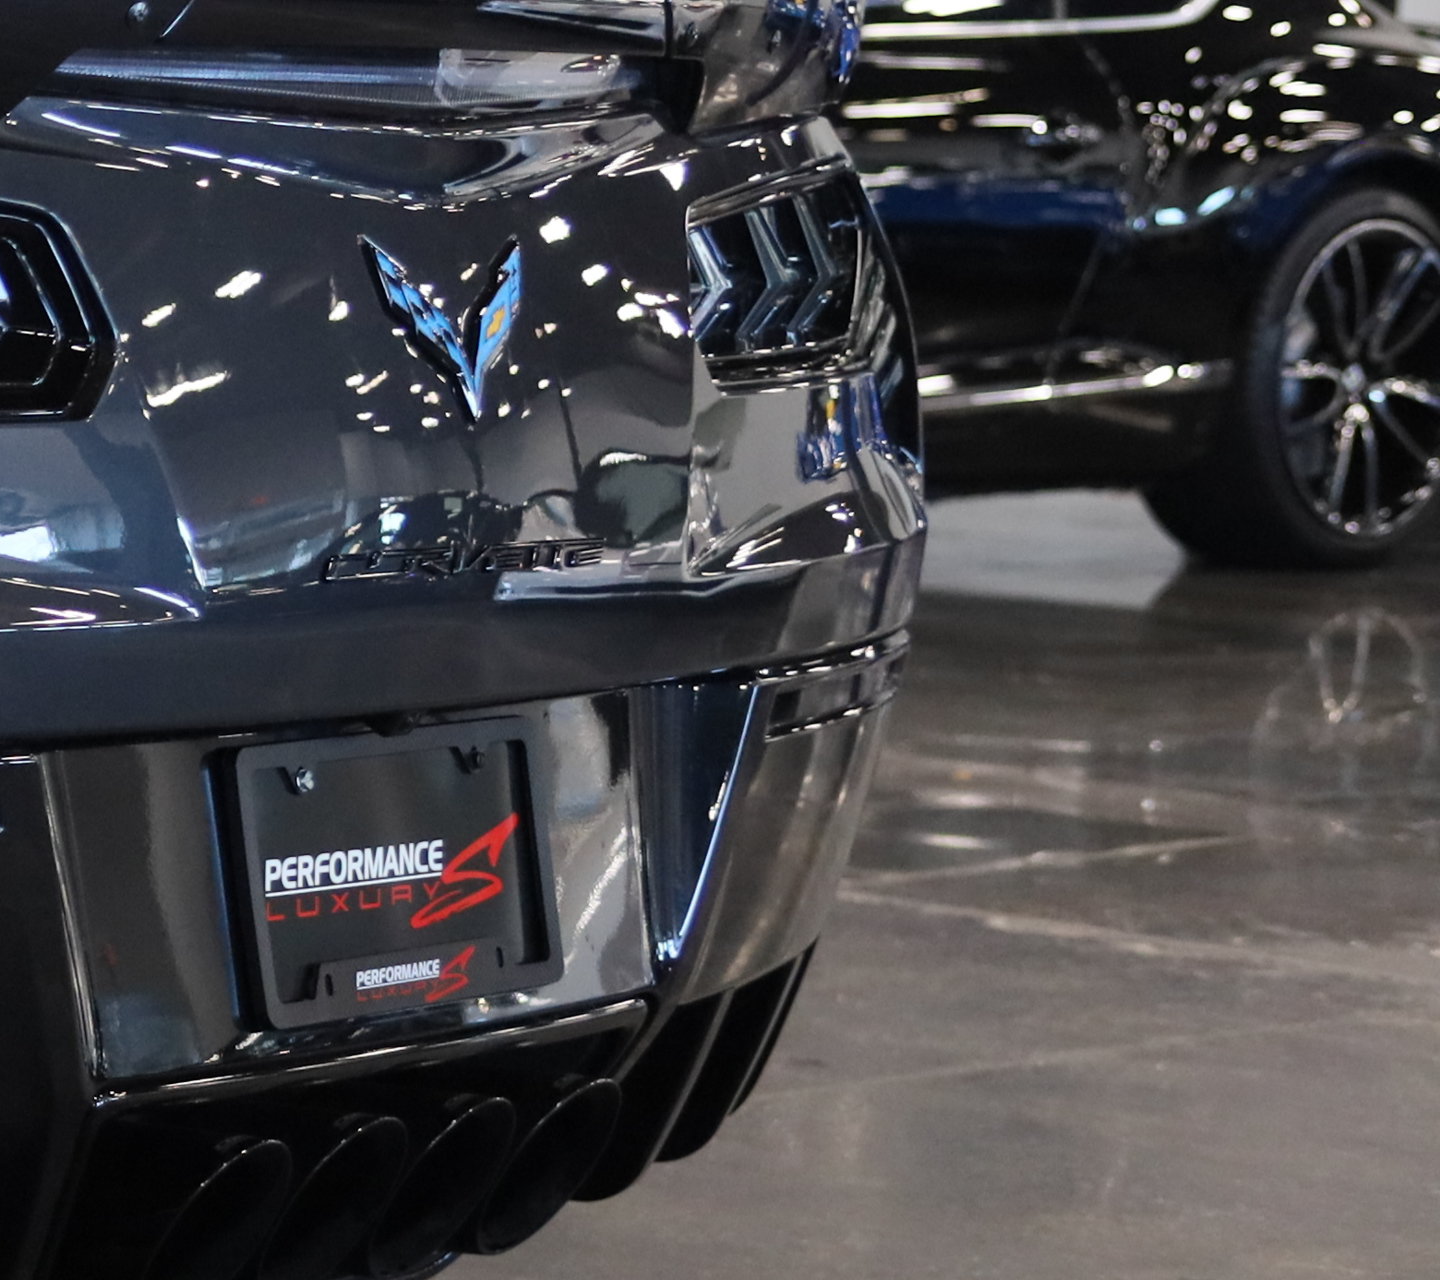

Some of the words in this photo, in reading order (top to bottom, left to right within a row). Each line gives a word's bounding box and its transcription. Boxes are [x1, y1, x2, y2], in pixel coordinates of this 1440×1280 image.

[265, 839, 443, 891] PERFORMANCE
[266, 882, 441, 921] LUXURY
[356, 959, 440, 988] PERFORMANCE
